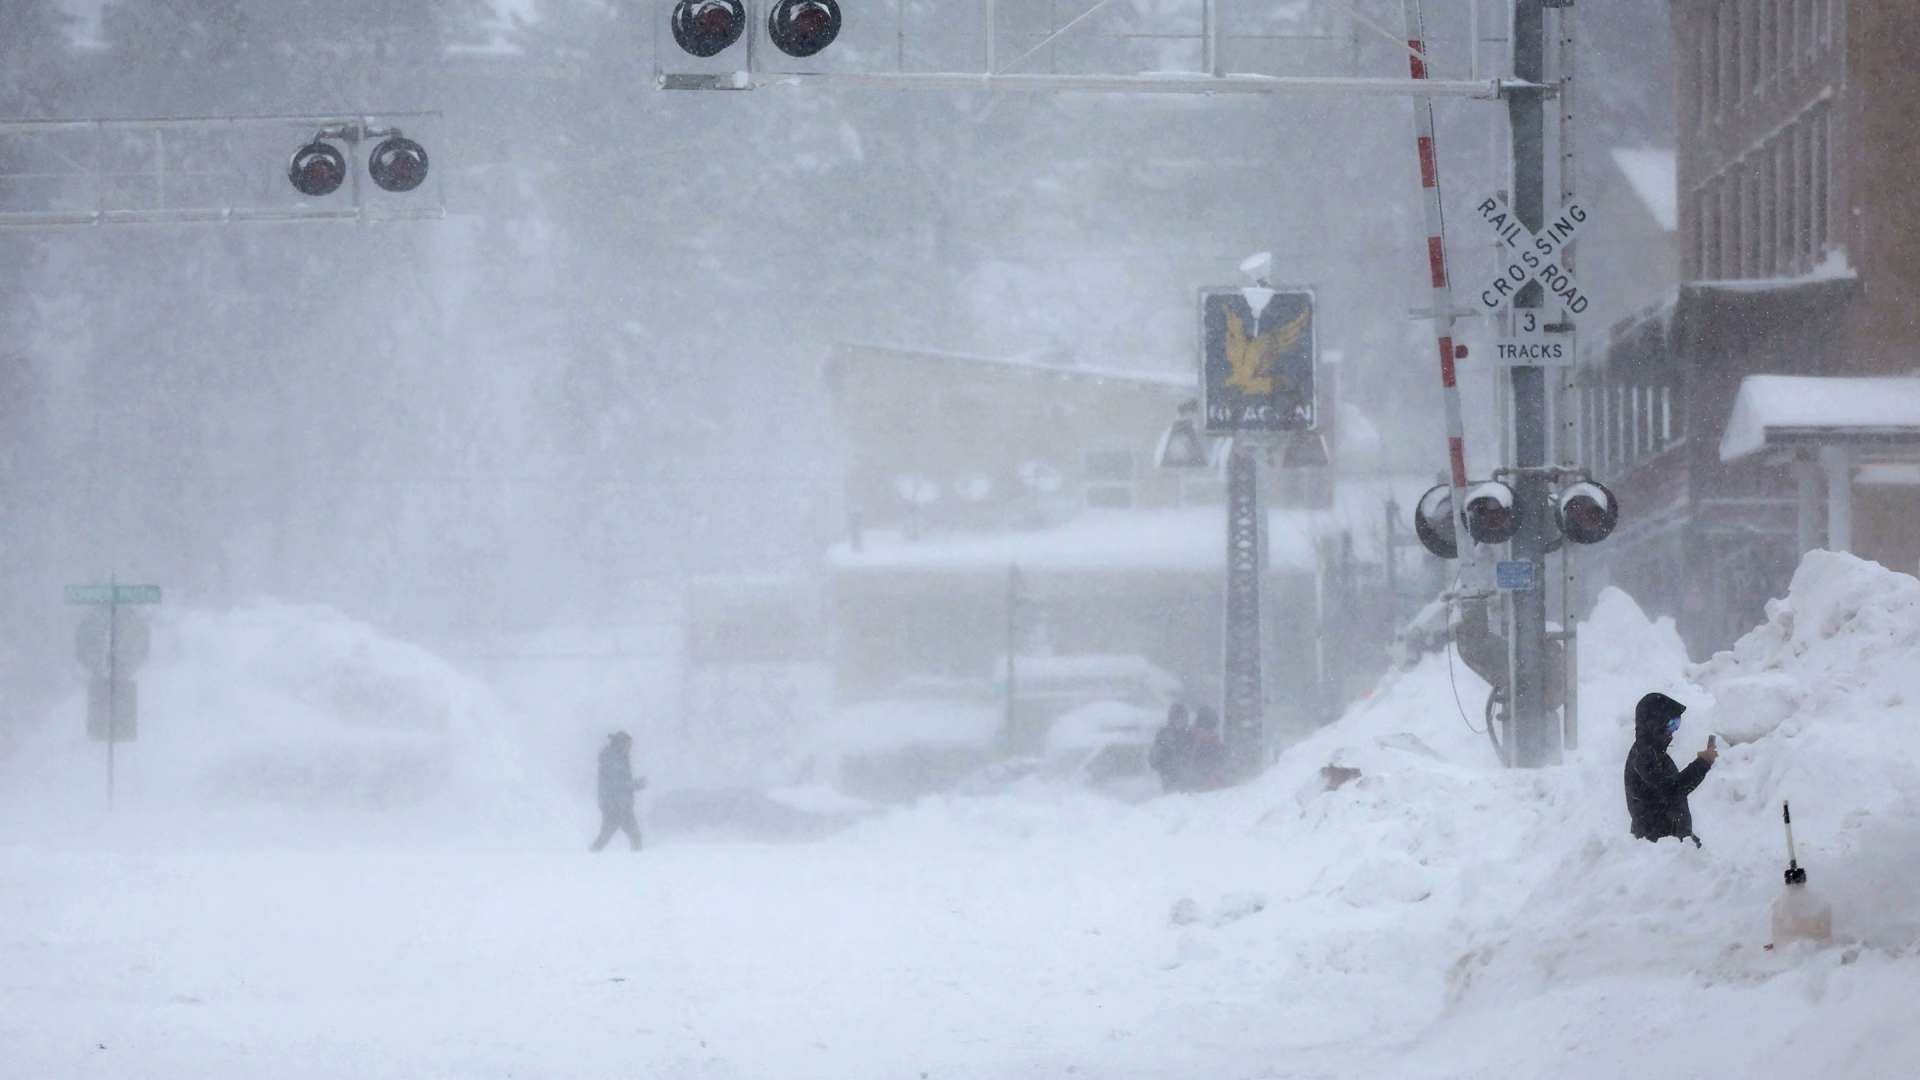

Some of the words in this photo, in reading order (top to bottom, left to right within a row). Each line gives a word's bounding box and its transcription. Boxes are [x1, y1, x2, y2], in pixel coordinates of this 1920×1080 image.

[1477, 197, 1521, 248] RAIL
[1539, 263, 1589, 314] ROAD
[1481, 205, 1587, 308] CROSSING
[1497, 343, 1563, 359] TRACKS
[1523, 312, 1536, 333] 3
